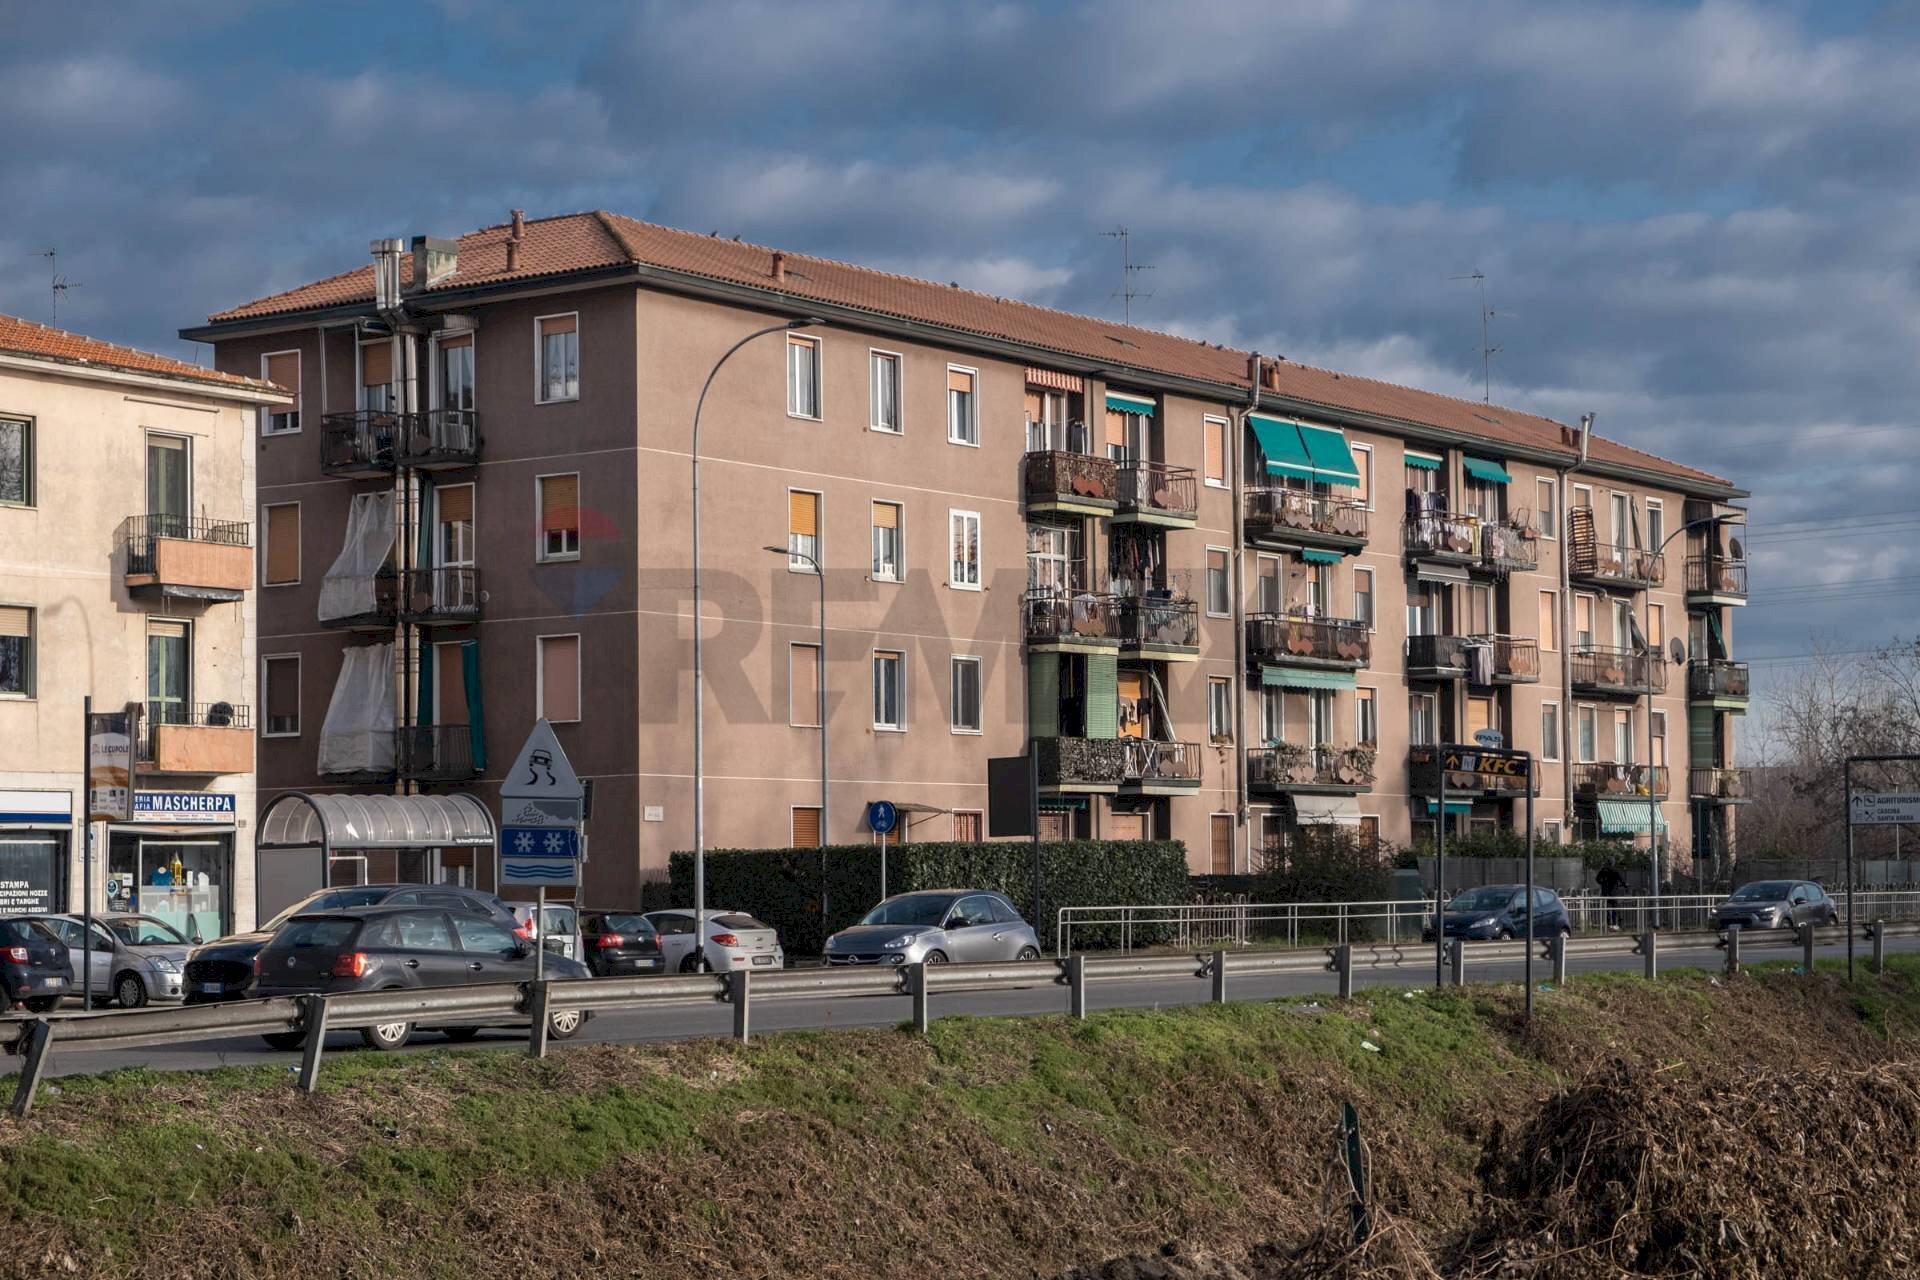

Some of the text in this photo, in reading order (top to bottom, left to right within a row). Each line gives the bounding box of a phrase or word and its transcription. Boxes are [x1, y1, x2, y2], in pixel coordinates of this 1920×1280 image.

[1477, 757, 1518, 775] KFC
[152, 795, 231, 811] MASCHERPA
[1877, 796, 1920, 804] AGRITURISM
[0, 880, 29, 889] STAMPA
